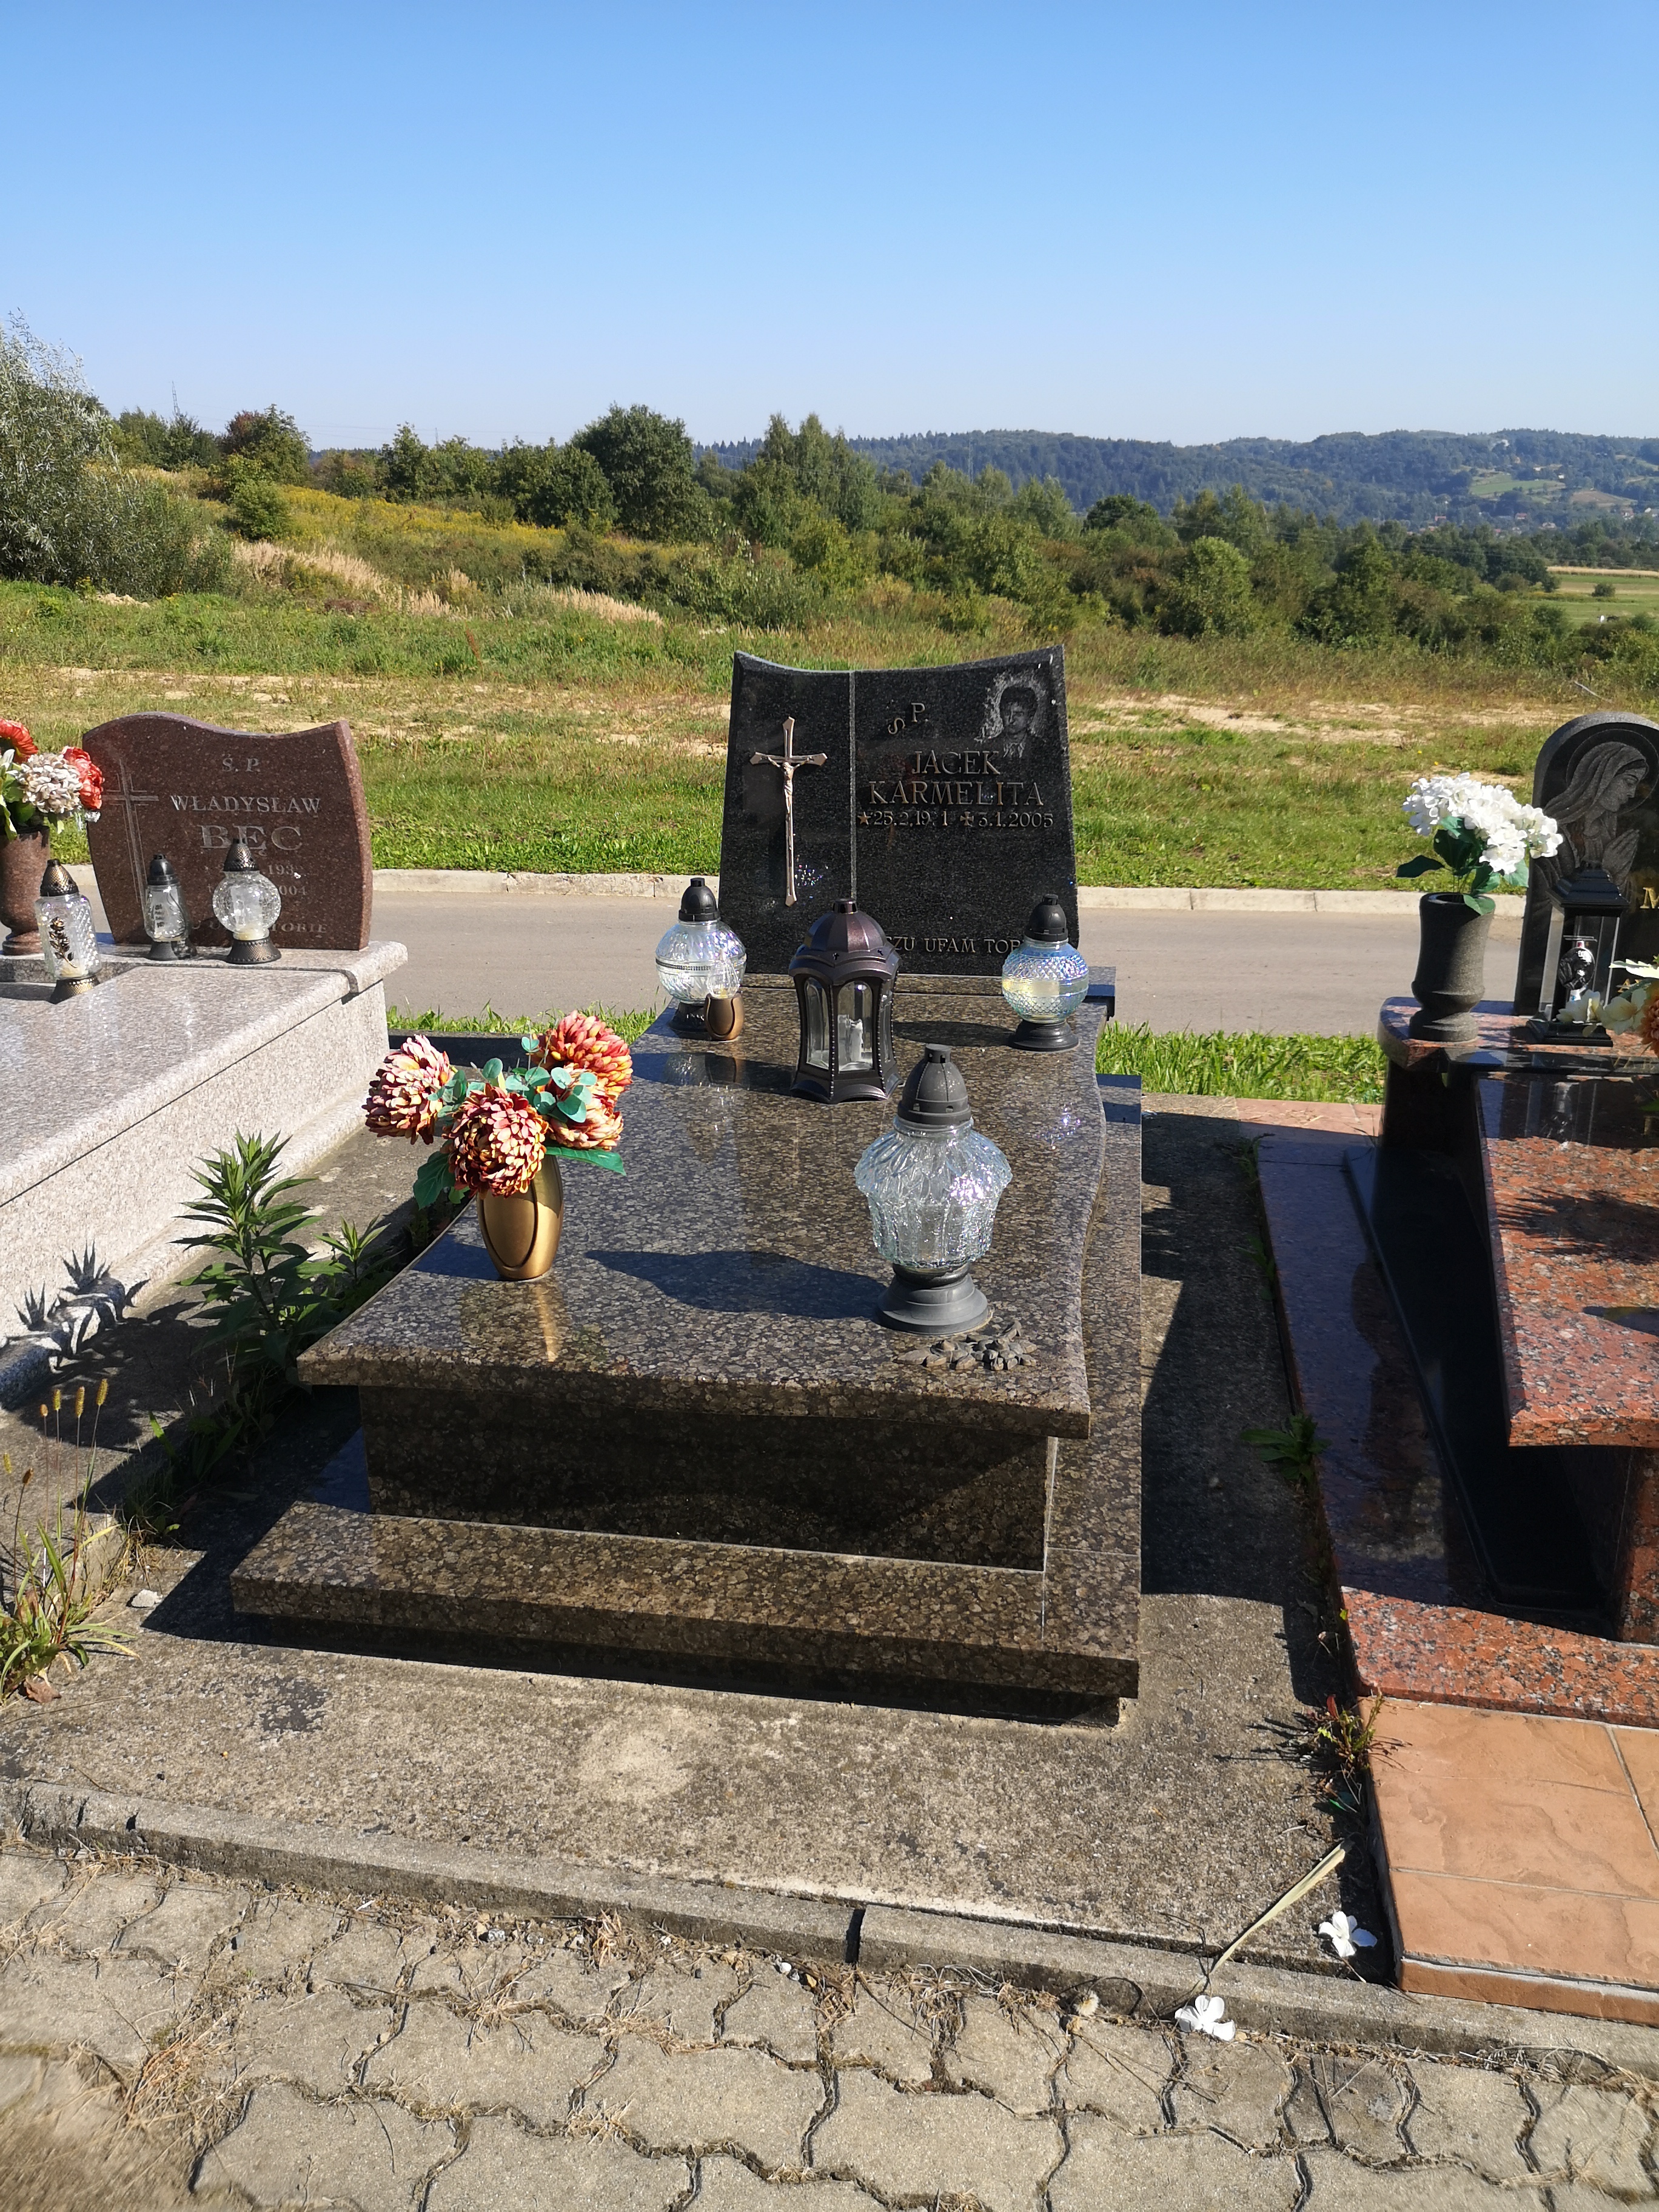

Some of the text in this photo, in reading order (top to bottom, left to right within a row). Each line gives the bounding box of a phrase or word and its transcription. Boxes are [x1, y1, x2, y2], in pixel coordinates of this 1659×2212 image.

[911, 749, 1000, 775] JACEK
[868, 780, 1044, 806] KARMELITA
[170, 795, 321, 813] WŁADYSŁAW
[978, 811, 1053, 828] 3.1.2005
[924, 937, 976, 953] UFAM
